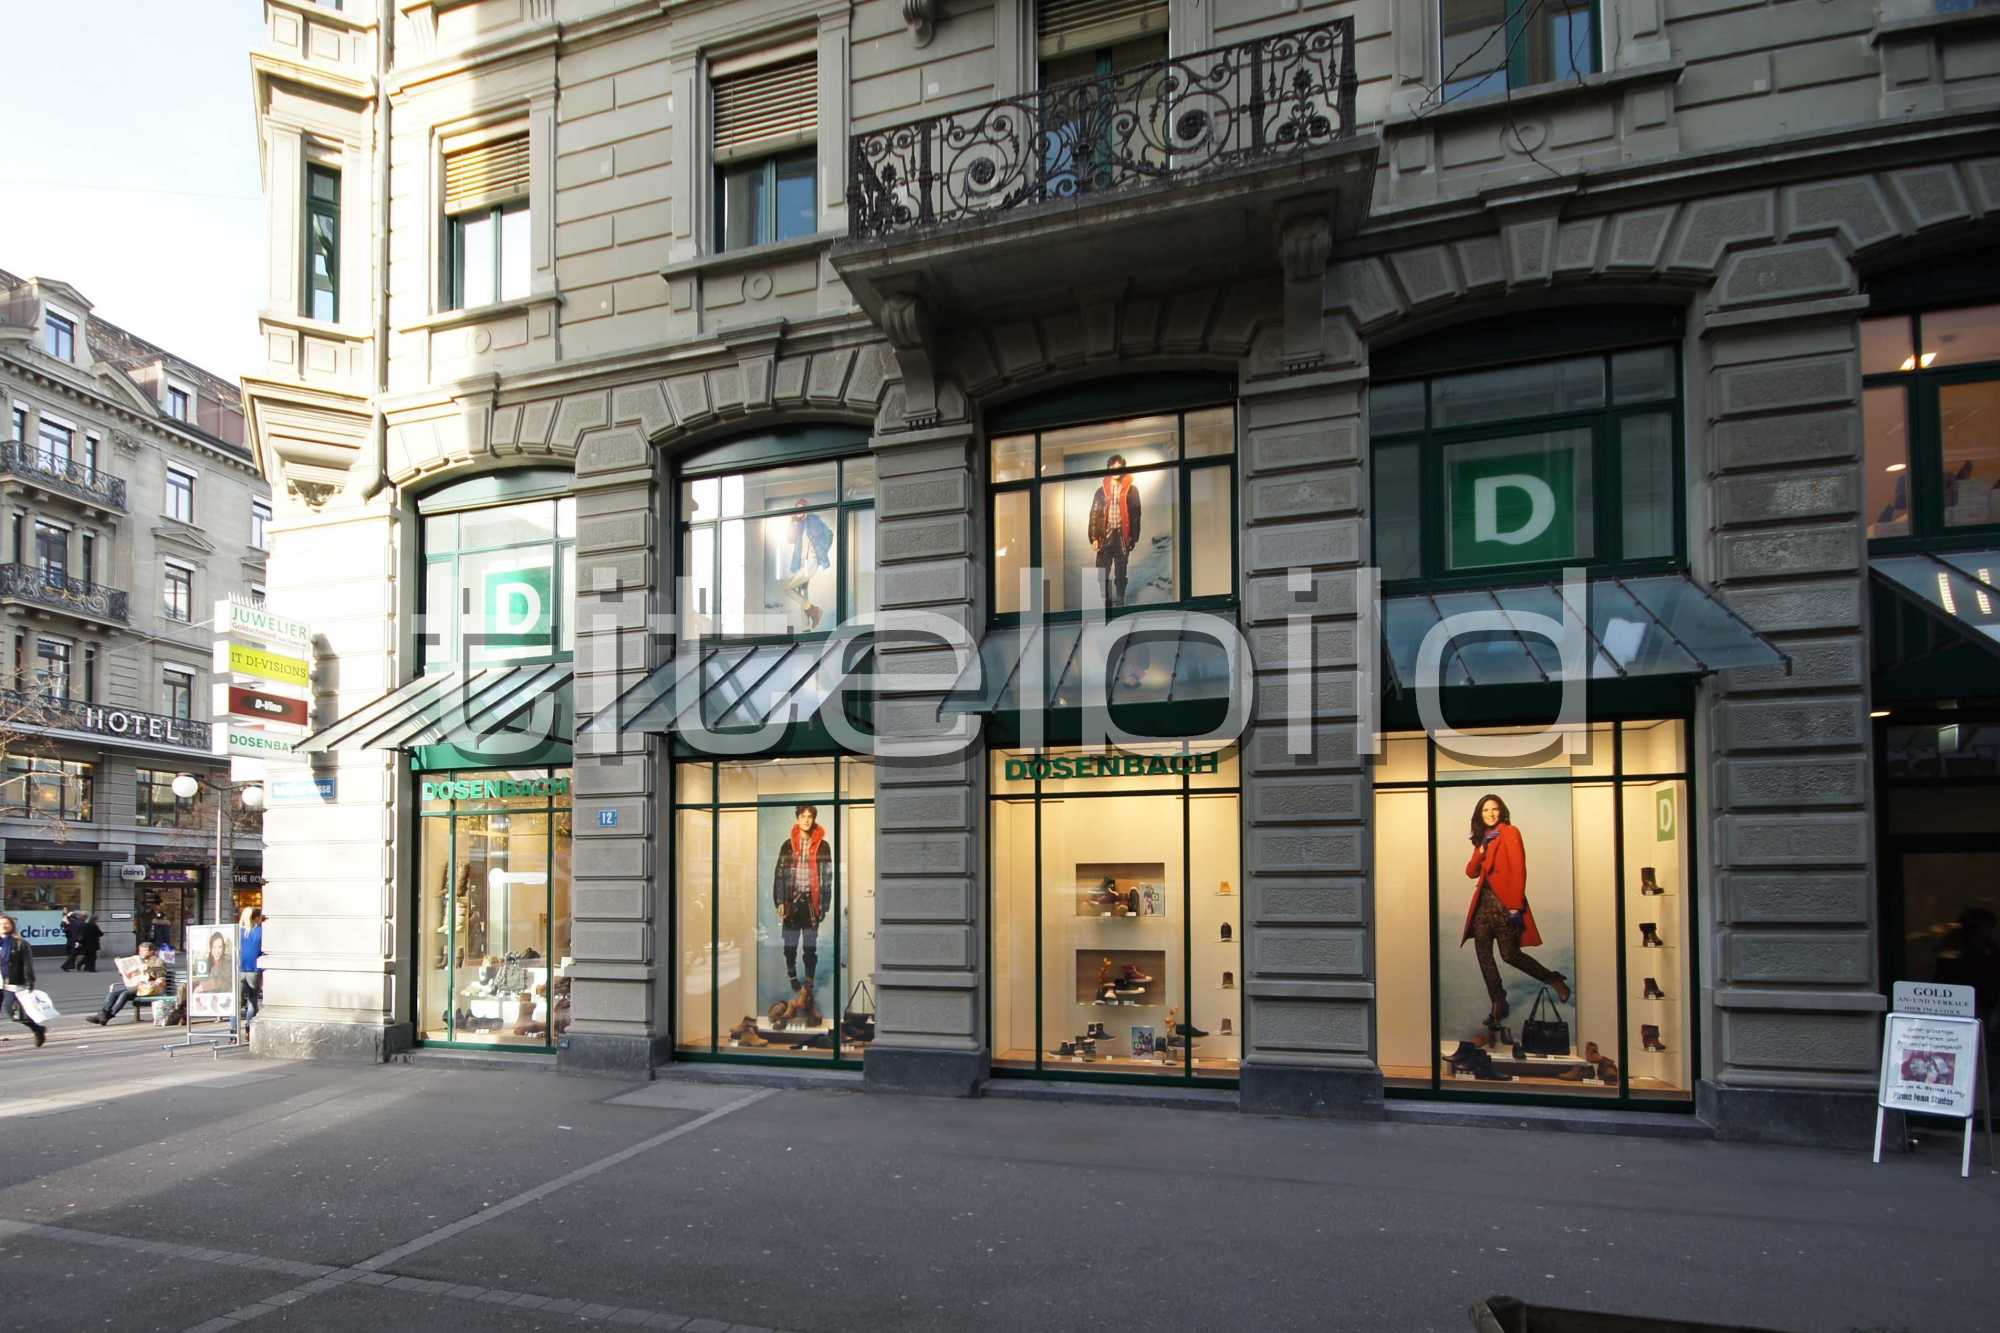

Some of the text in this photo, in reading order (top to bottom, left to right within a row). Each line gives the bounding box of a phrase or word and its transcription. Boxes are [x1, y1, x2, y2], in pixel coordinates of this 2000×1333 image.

[1474, 473, 1556, 545] D
[231, 606, 307, 640] JUWELIER
[495, 582, 541, 636] D
[231, 652, 306, 678] IT DI-VISIONS
[86, 707, 180, 740] HOTEL
[1005, 751, 1219, 781] DOSENBACH
[422, 777, 570, 800] DOSENBACH
[602, 812, 613, 824] 12
[1913, 987, 1953, 998] GOLD
